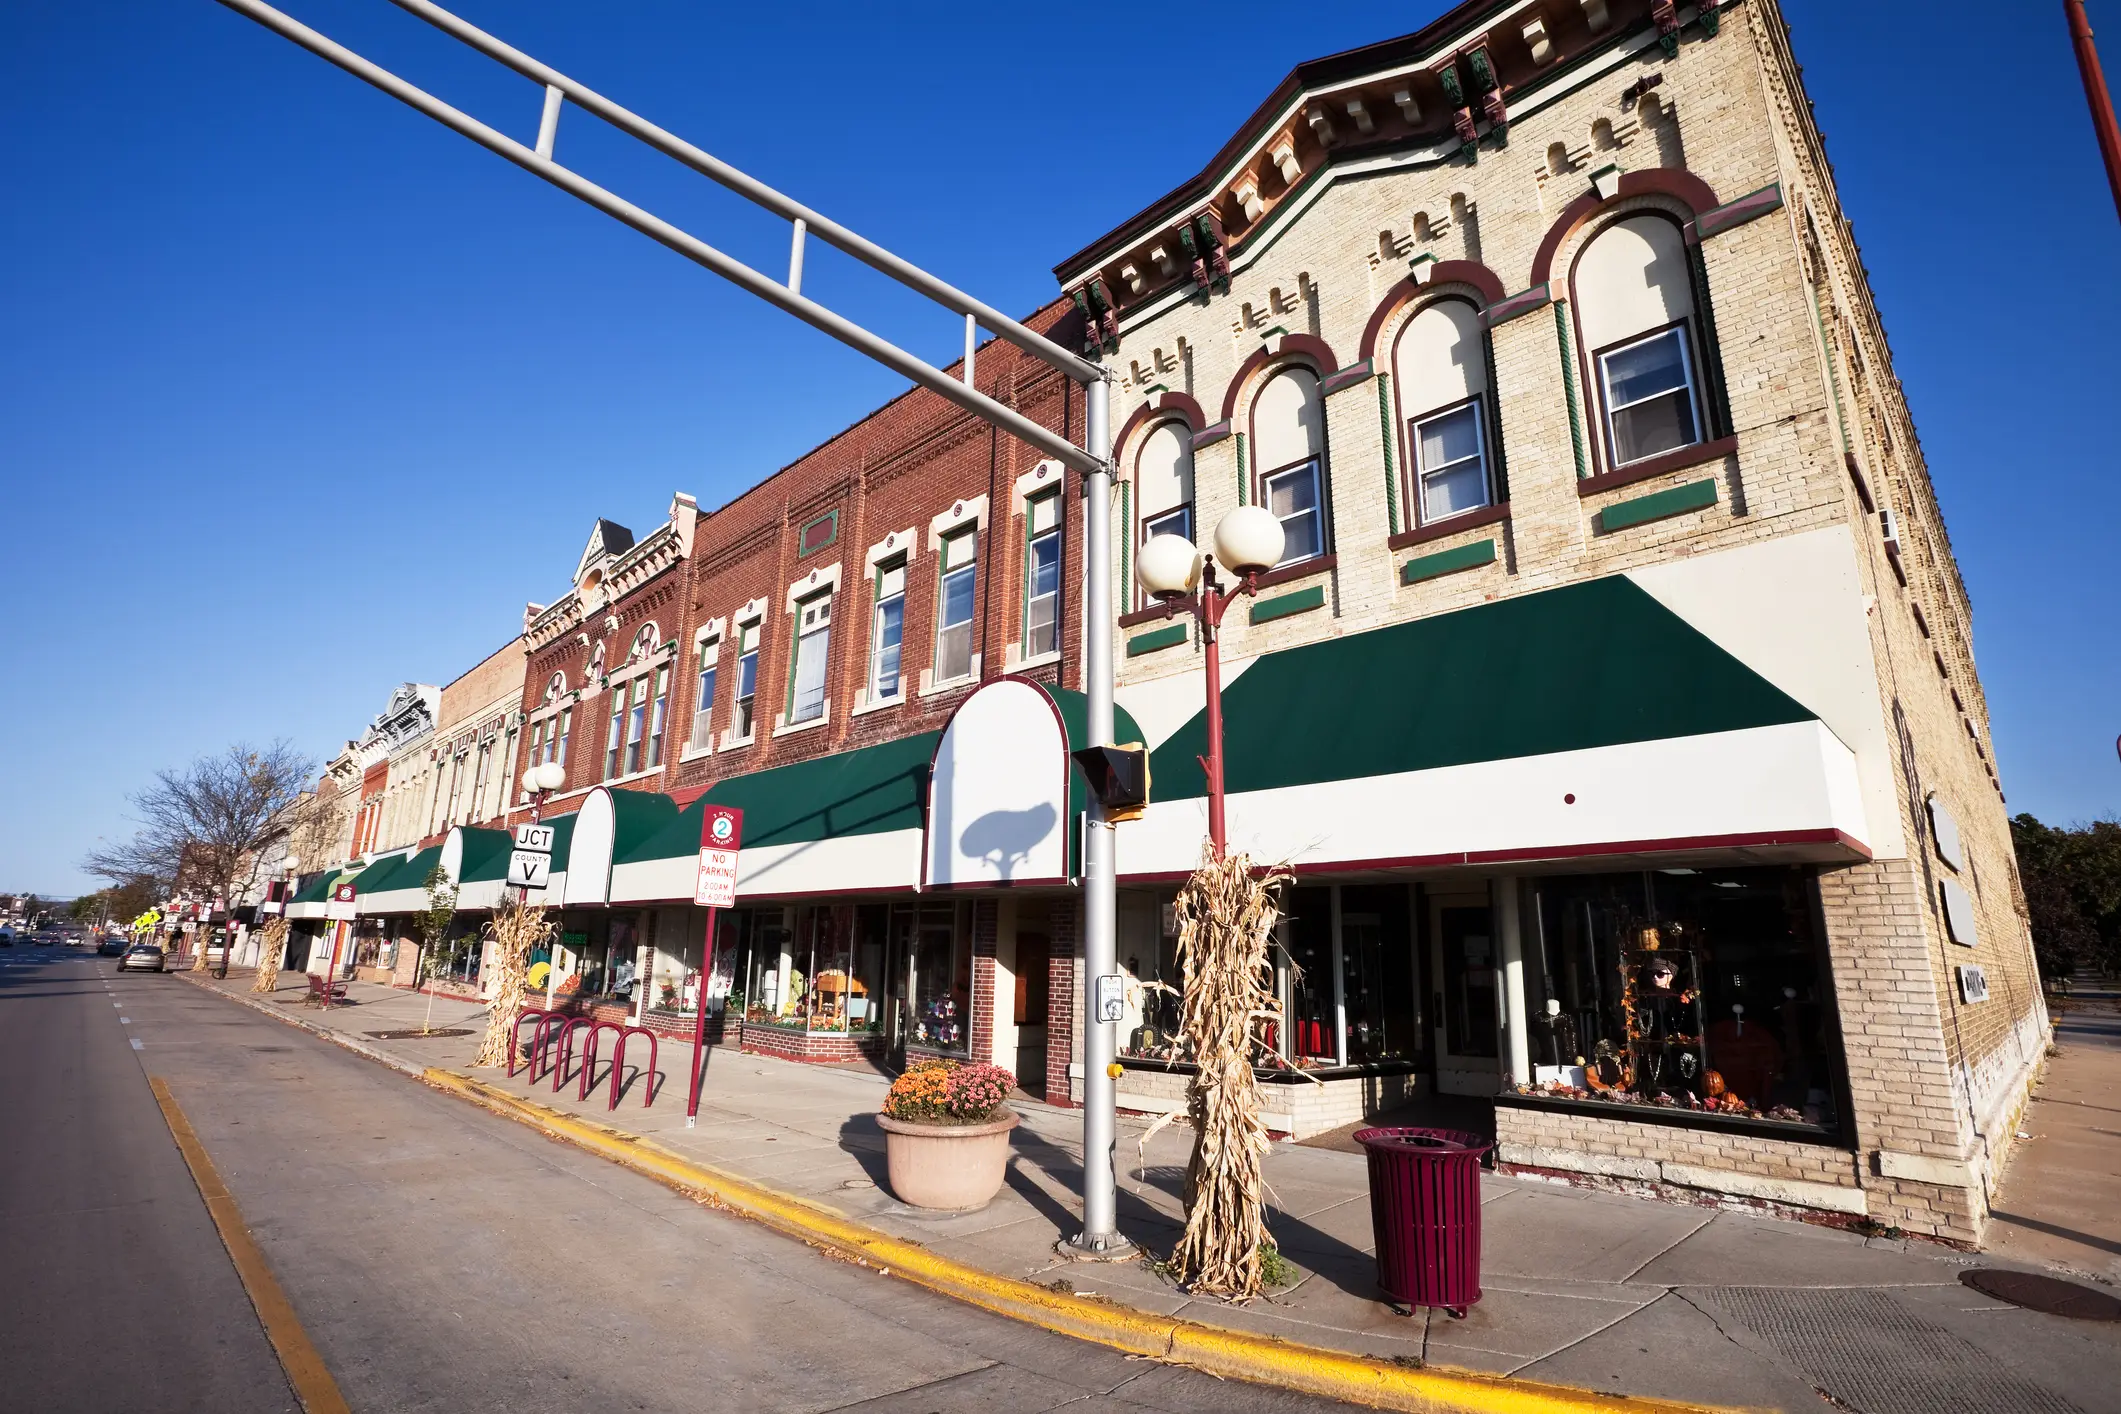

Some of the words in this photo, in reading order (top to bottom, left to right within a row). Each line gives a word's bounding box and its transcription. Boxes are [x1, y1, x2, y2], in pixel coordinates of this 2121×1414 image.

[717, 820, 727, 835] 2
[519, 829, 550, 846] JCT
[710, 834, 734, 845] PARKING
[515, 854, 548, 862] COUNTY
[712, 854, 725, 864] NO
[523, 863, 538, 880] V
[701, 865, 734, 878] PARKING
[704, 882, 728, 890] 200AM
[708, 894, 732, 902] 600AM
